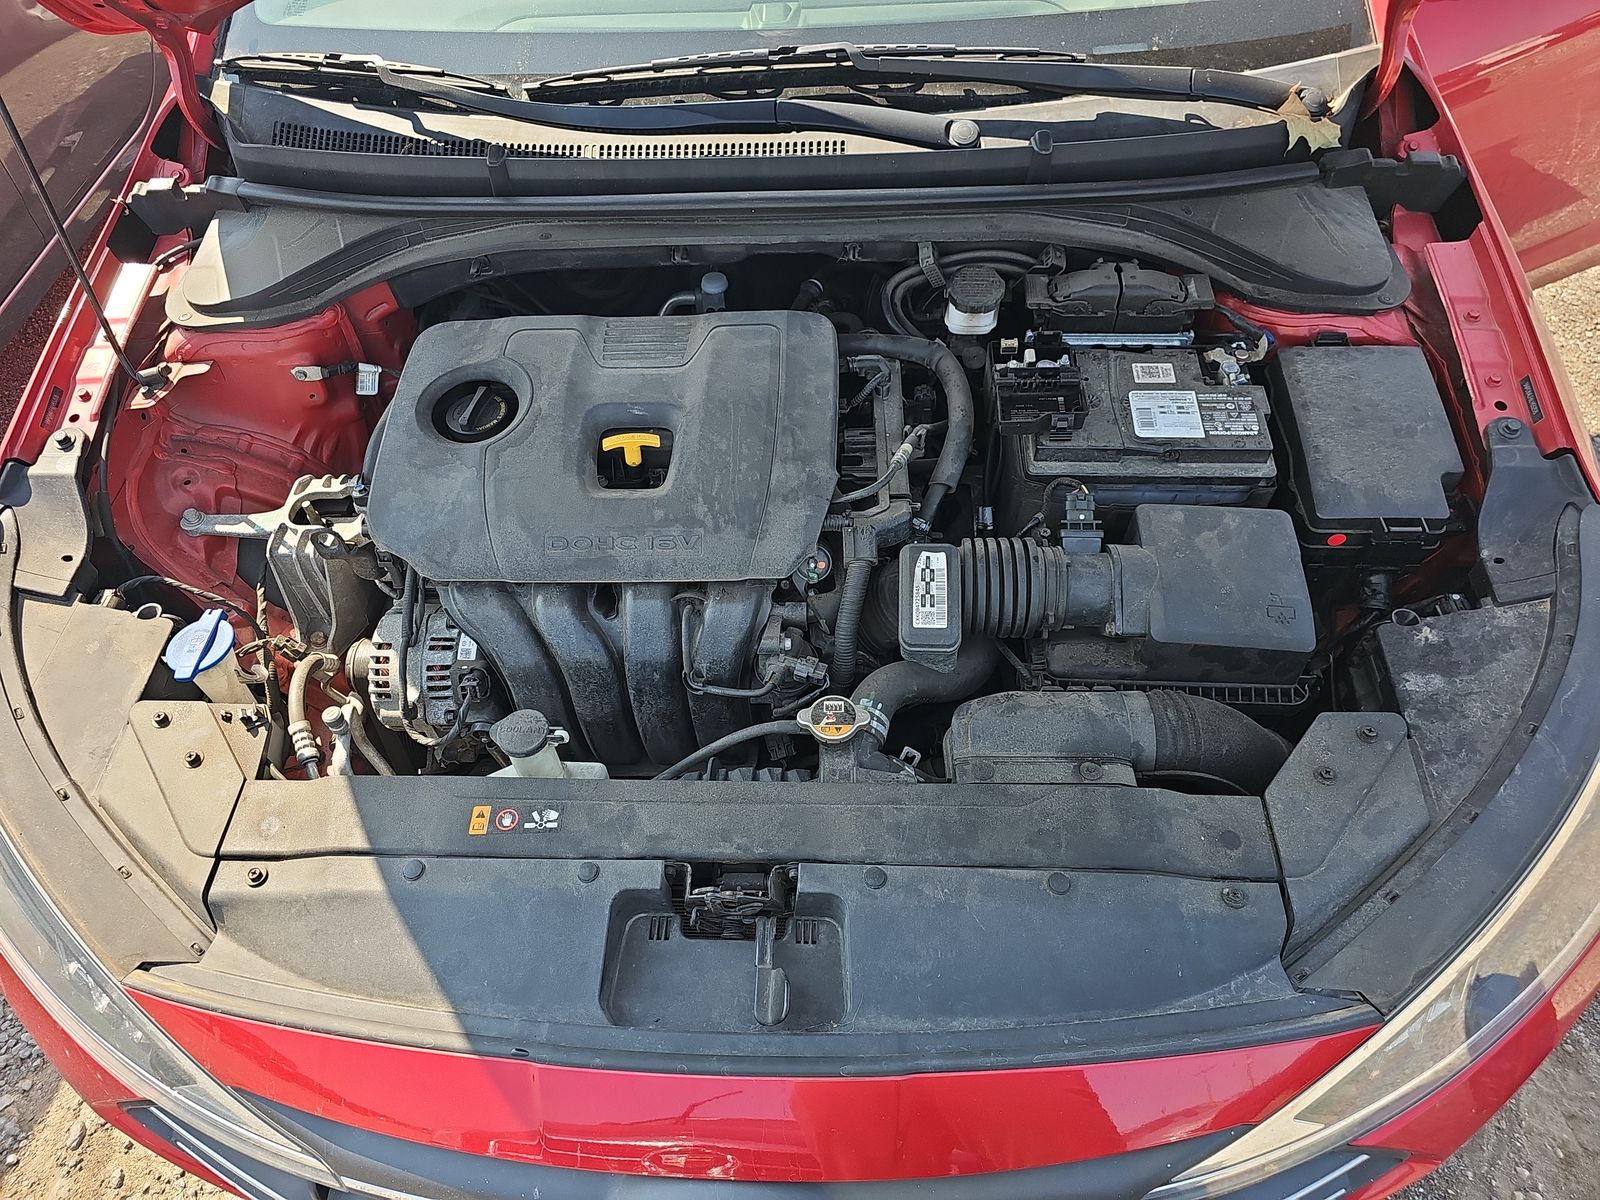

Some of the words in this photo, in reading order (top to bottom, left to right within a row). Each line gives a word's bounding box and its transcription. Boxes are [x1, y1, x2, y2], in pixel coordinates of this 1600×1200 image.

[547, 535, 638, 551] DOHC
[645, 534, 700, 551] 16V
[500, 726, 546, 735] COOLANT
